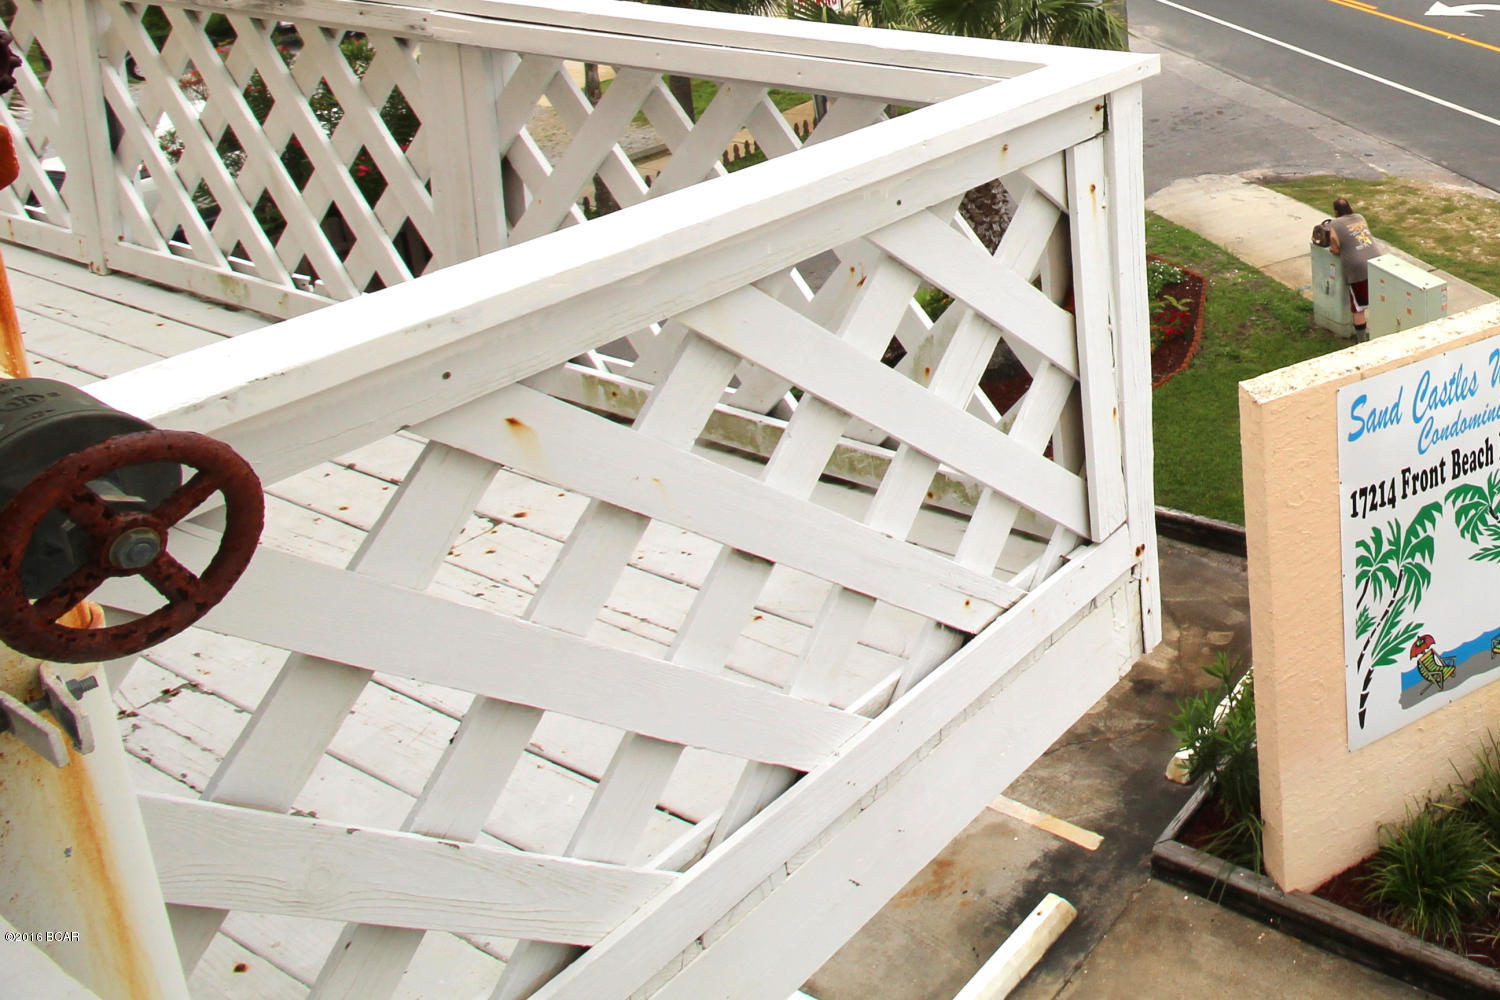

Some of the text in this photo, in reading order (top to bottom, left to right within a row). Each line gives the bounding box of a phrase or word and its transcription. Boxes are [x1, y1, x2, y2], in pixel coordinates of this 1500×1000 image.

[1347, 383, 1403, 443] Sand
[1412, 364, 1479, 424] Castles
[1350, 477, 1397, 519] 17214
[1401, 456, 1447, 500] Front
[1451, 437, 1495, 480] Beach
